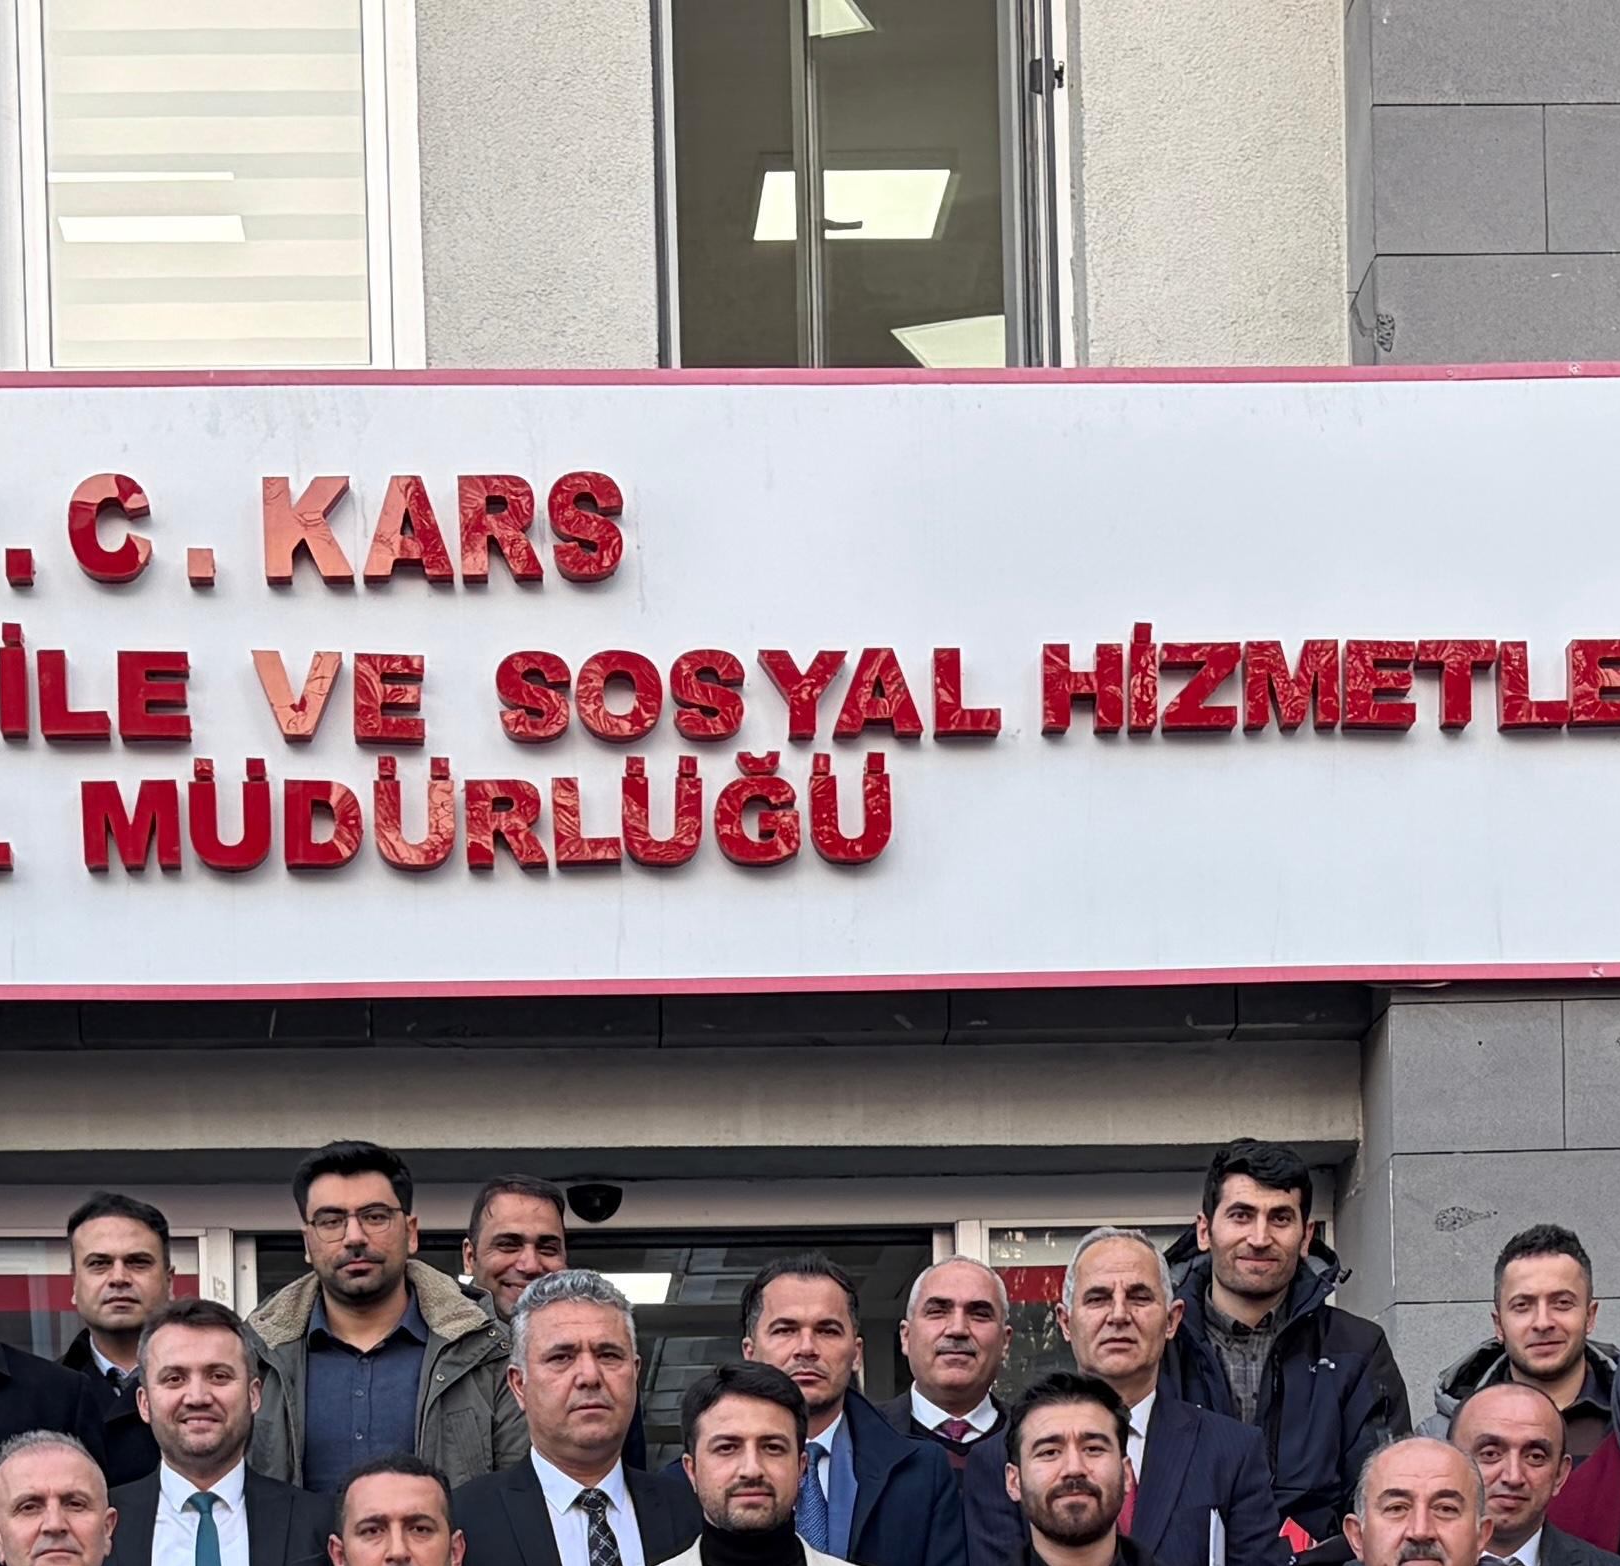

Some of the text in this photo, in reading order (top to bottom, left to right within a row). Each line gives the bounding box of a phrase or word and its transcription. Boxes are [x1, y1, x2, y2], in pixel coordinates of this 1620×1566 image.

[262, 471, 624, 588] KARS
[251, 649, 426, 747] VE
[495, 645, 1002, 745] SOSYAL
[80, 751, 894, 873] MÜDÜRLÜĞÜ
